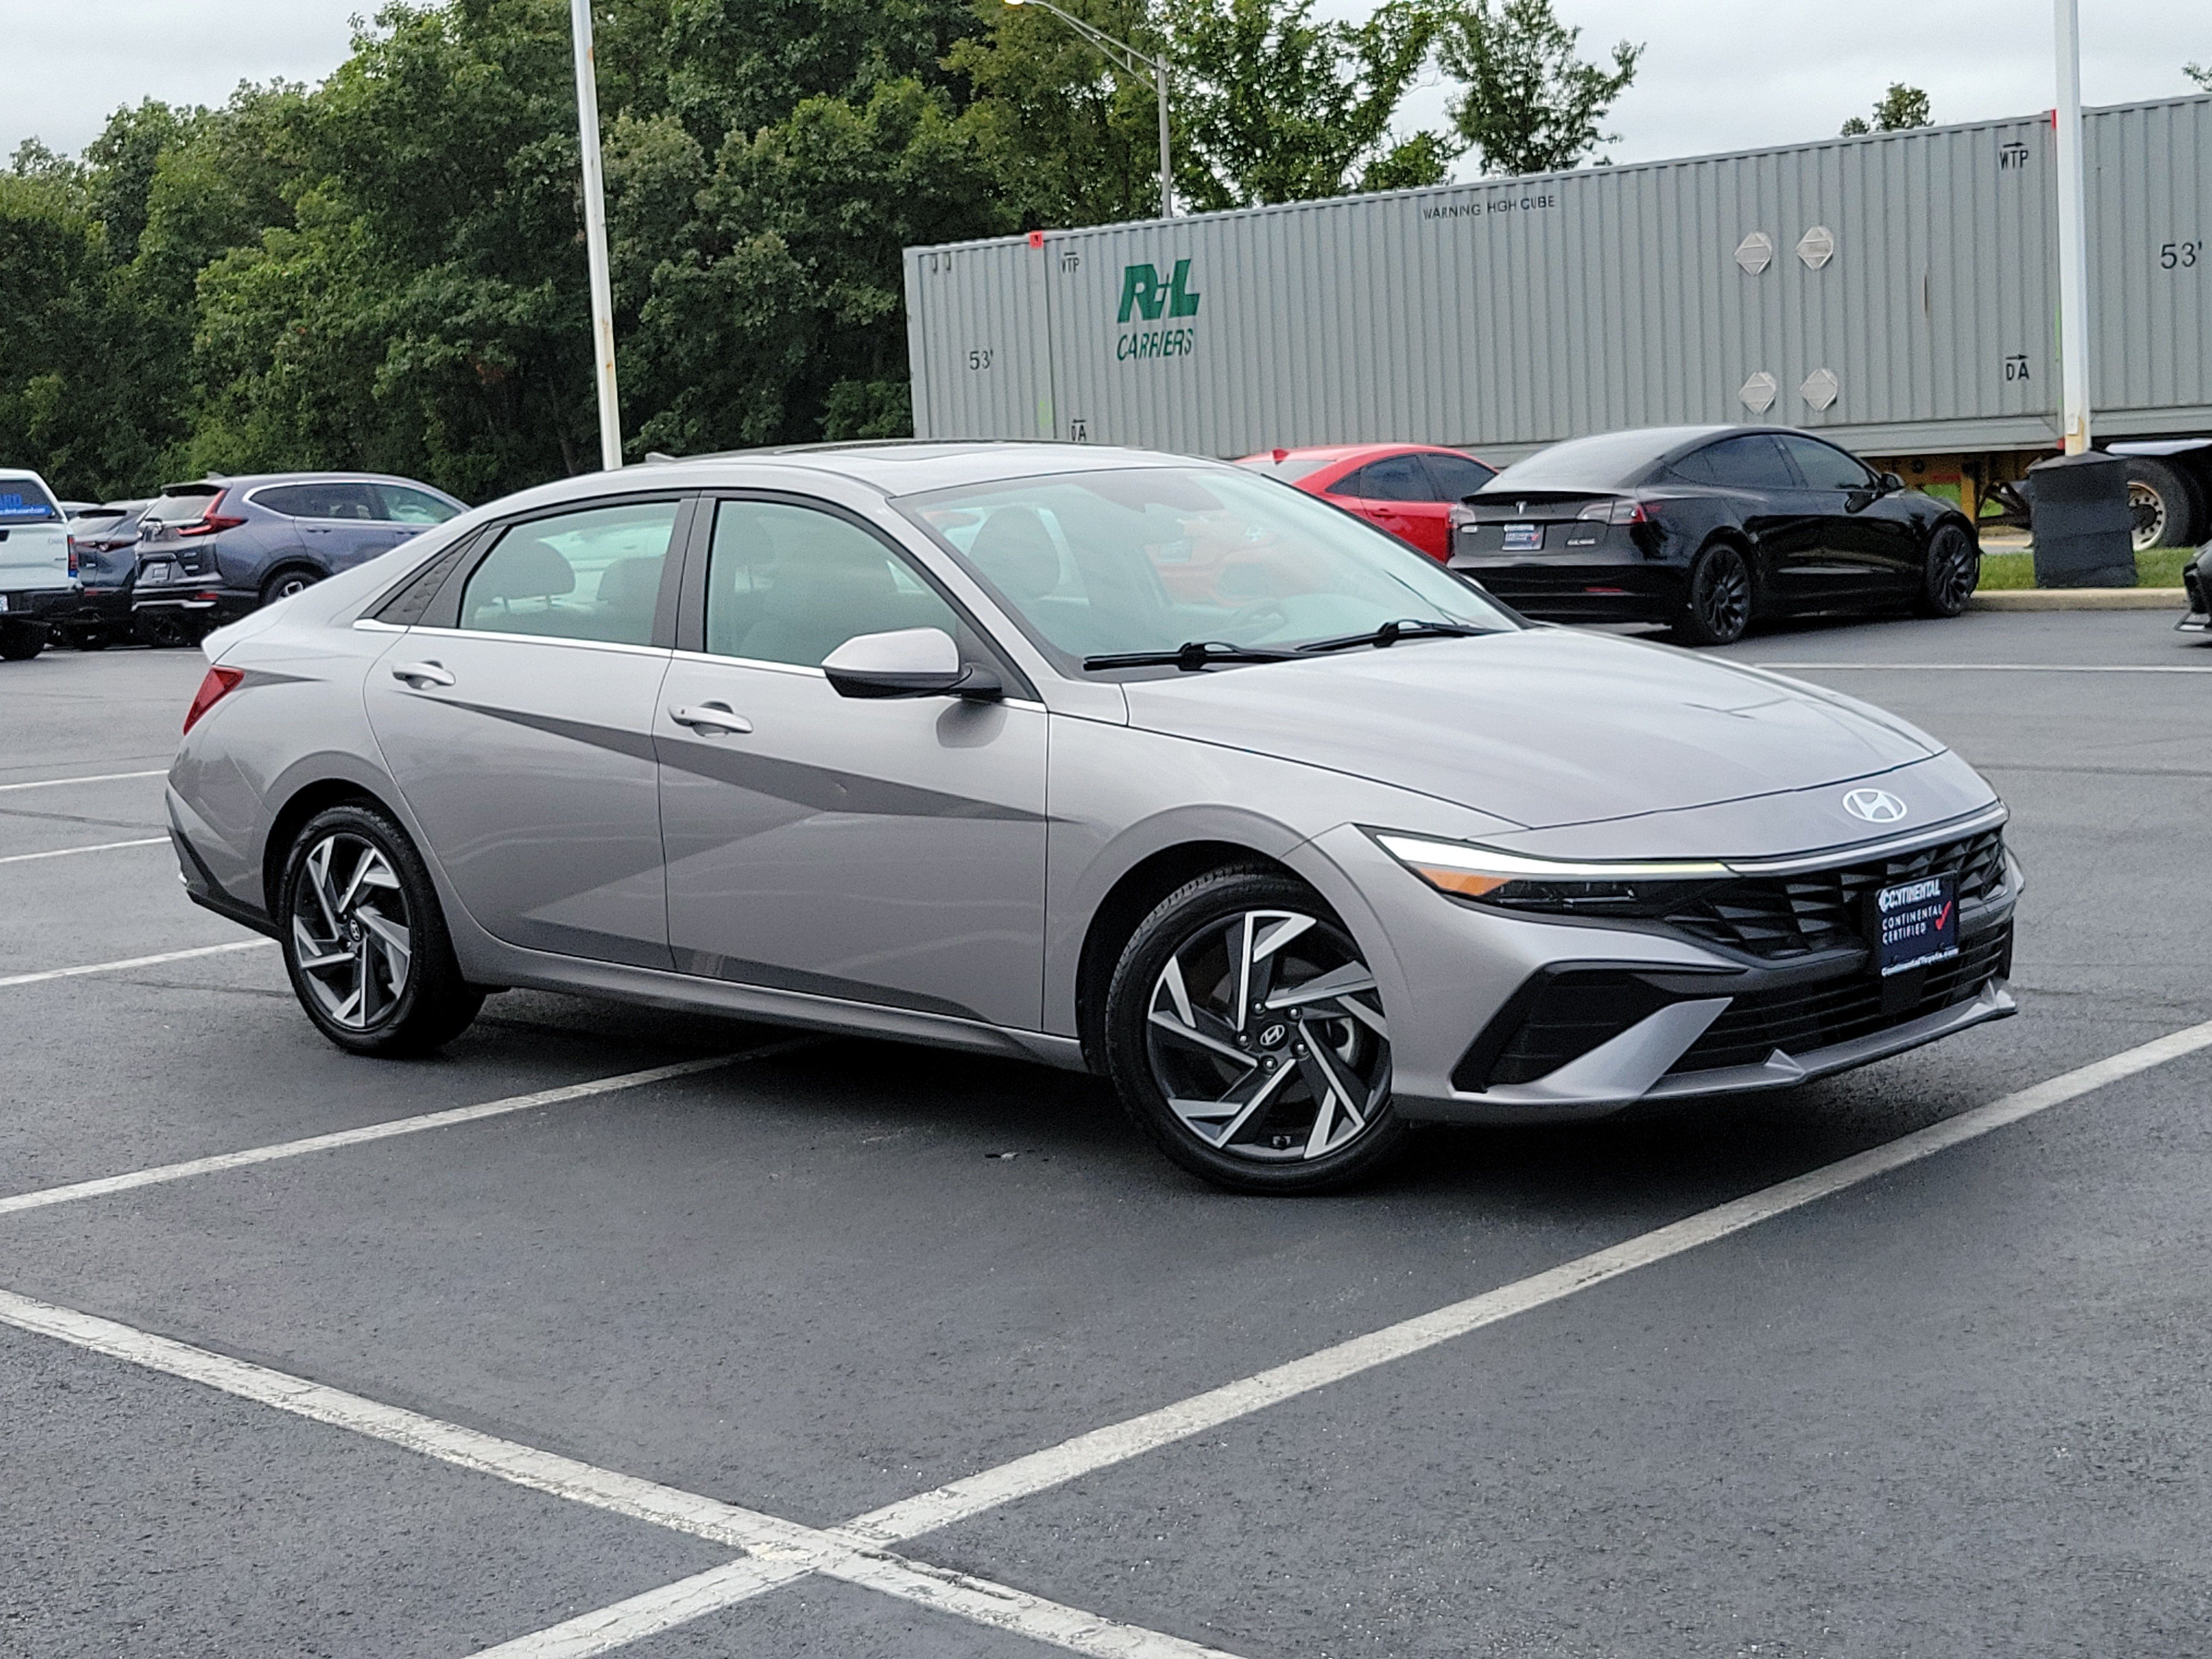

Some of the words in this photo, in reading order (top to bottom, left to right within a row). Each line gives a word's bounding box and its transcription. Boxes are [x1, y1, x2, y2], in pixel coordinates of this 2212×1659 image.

[2161, 241, 2202, 269] 53'
[1117, 328, 1194, 361] CARRIERS
[969, 348, 993, 370] 53'
[2006, 362, 2029, 381] DA
[1882, 903, 1943, 930] CONTINENTAL
[1882, 922, 1927, 945] CERTIFIED
